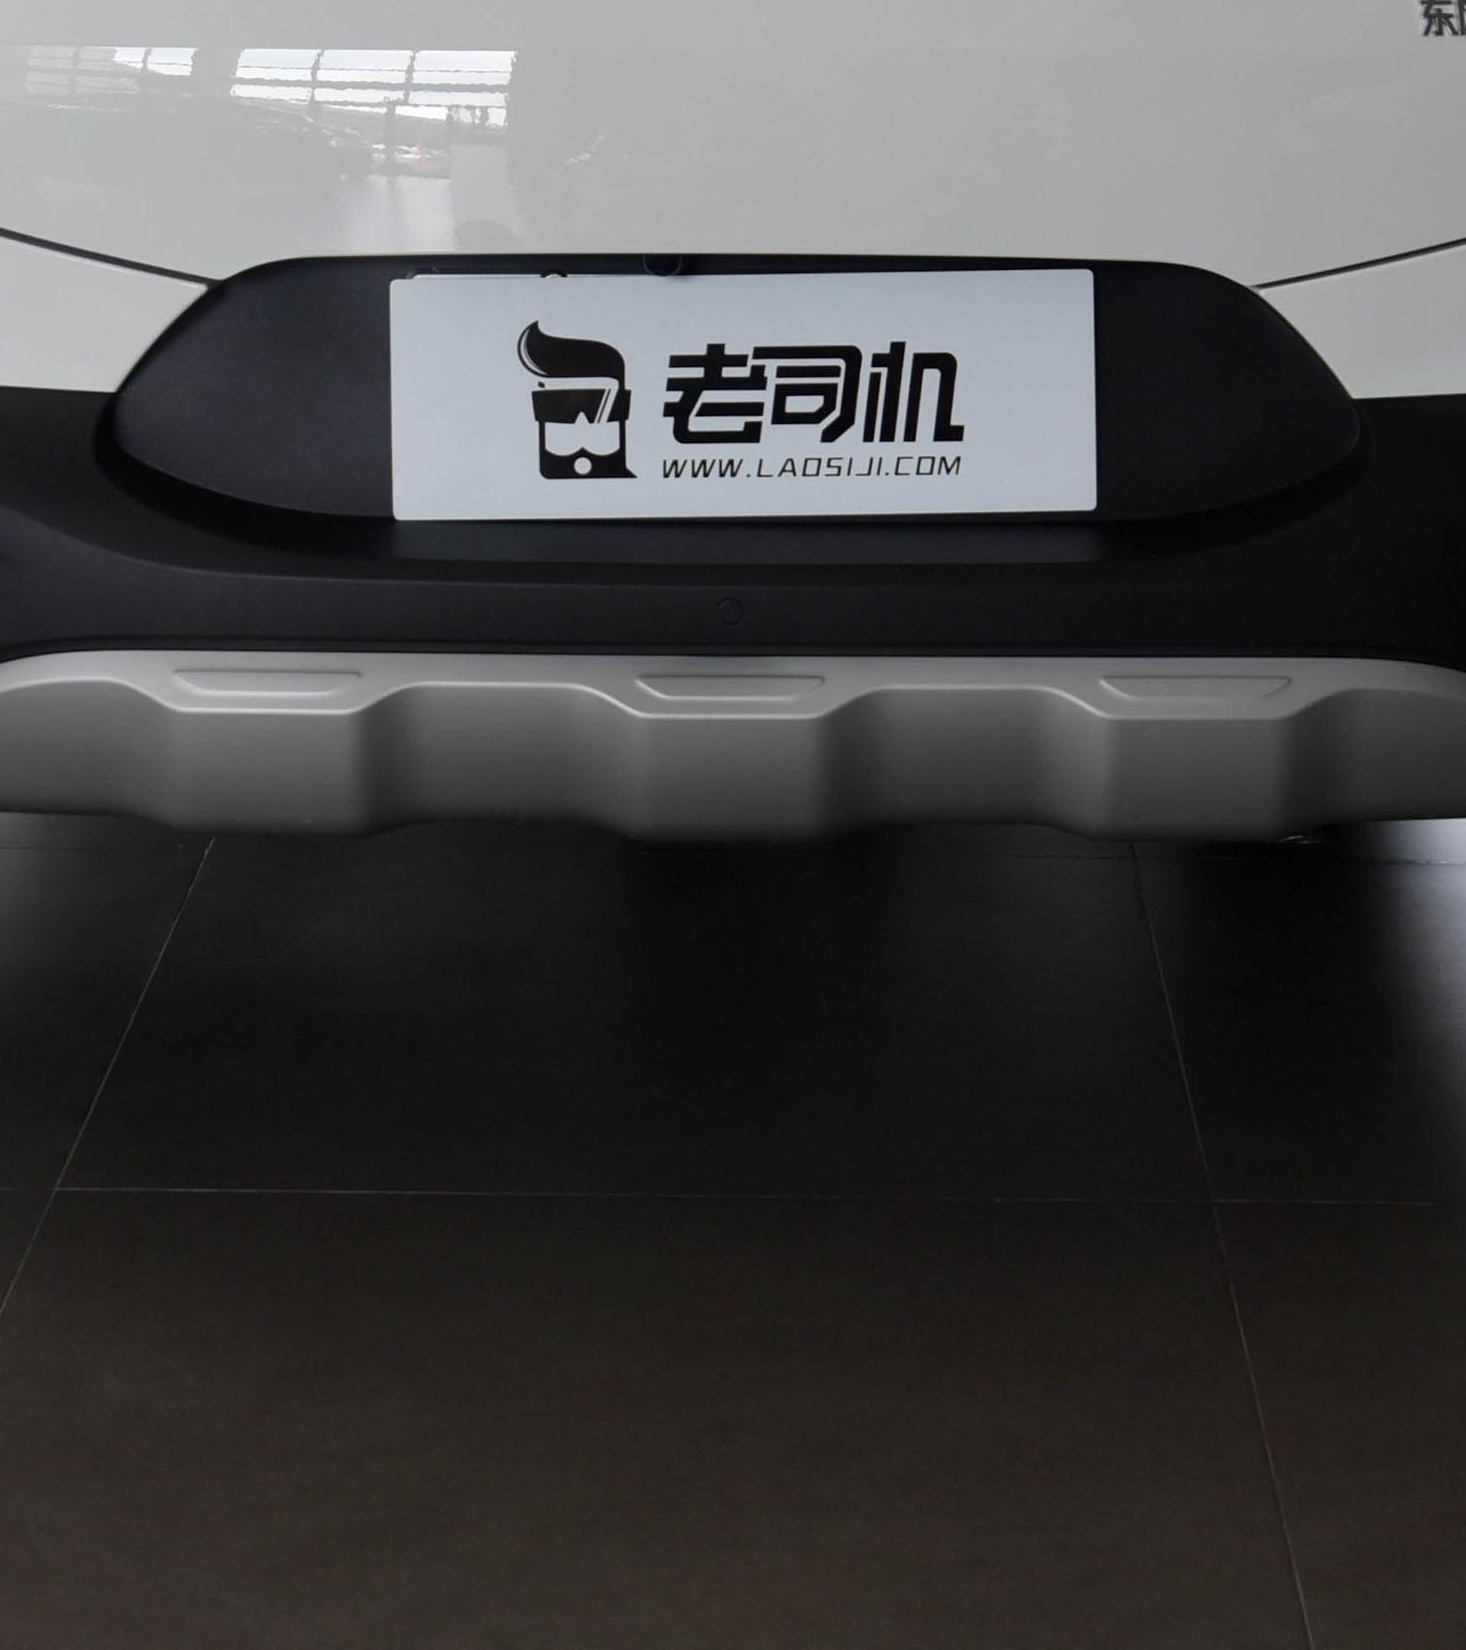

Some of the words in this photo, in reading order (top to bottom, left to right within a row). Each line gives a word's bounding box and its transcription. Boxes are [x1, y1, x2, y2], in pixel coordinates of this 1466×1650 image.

[662, 341, 966, 445] 老司机
[661, 455, 962, 479] WWW.LAOSIJI.COM
